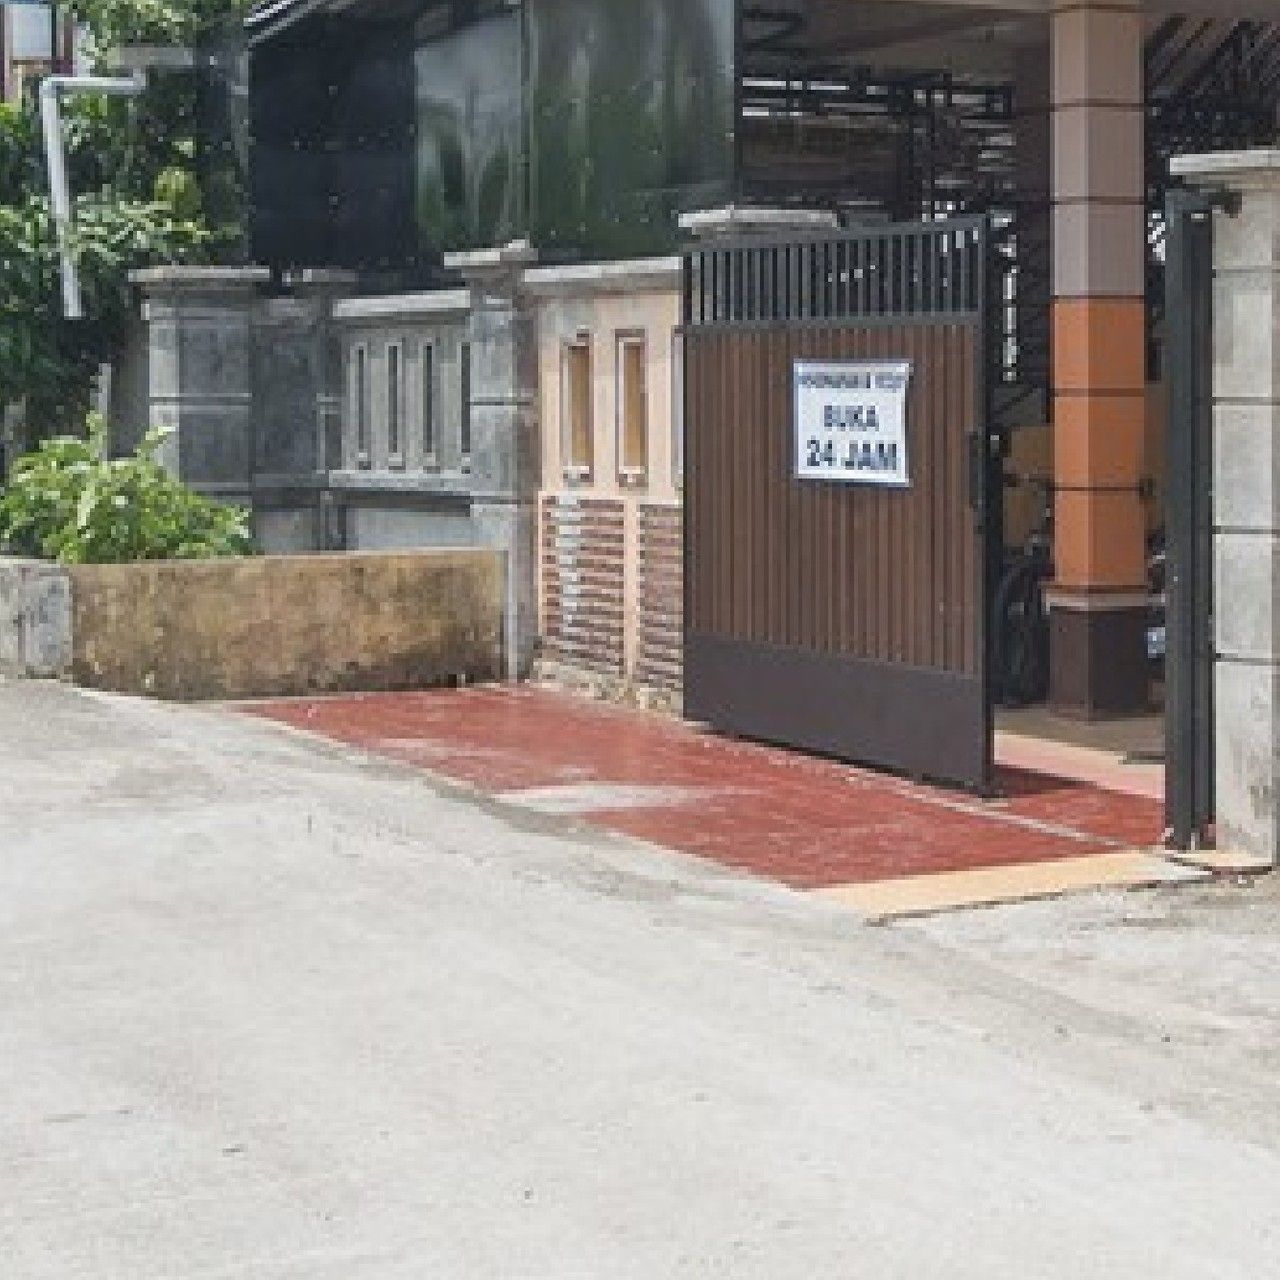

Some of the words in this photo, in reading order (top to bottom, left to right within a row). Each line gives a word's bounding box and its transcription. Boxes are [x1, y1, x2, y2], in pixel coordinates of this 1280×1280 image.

[823, 404, 879, 431] BUKA
[806, 436, 836, 468] 24
[843, 439, 898, 472] JAM
